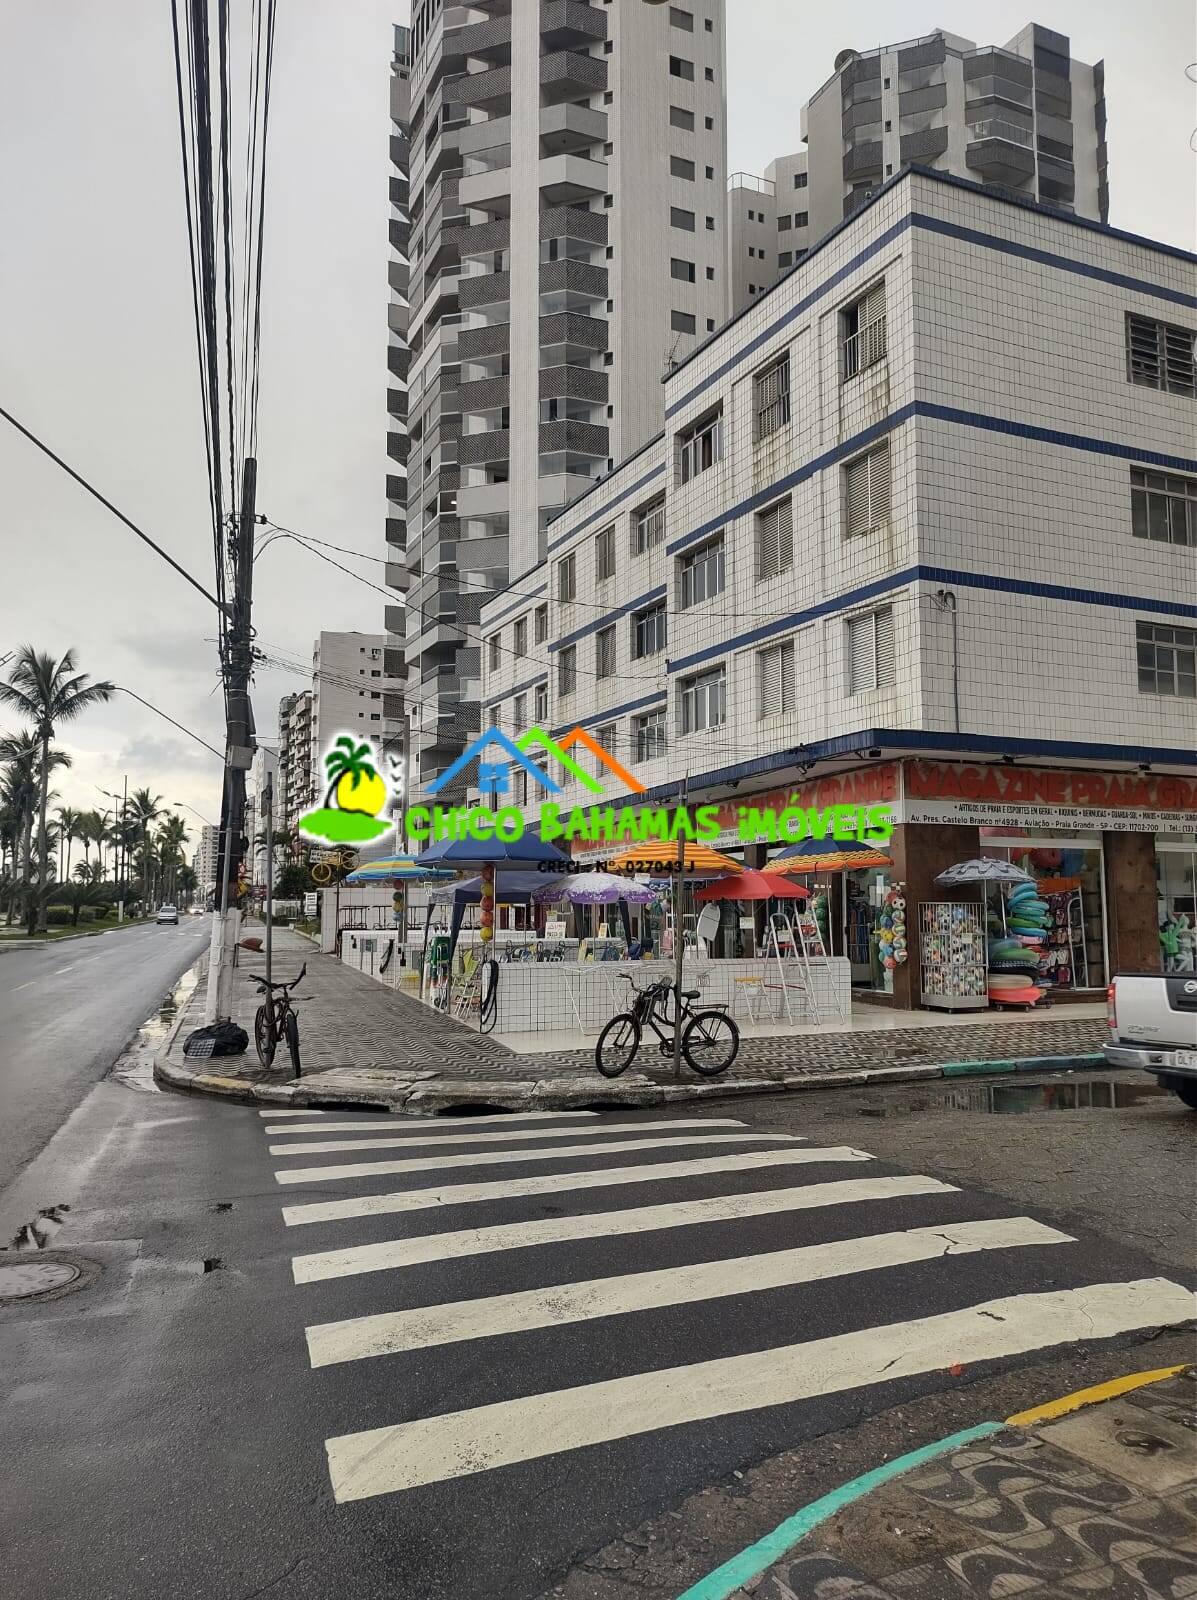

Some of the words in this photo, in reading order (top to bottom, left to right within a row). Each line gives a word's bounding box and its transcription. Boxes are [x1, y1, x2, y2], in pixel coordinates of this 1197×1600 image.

[817, 764, 898, 808] GRANDE
[909, 764, 1065, 804] MAGAZINE
[1070, 774, 1153, 807] PRAIA
[942, 816, 967, 824] Castelo
[969, 817, 993, 825] Branco
